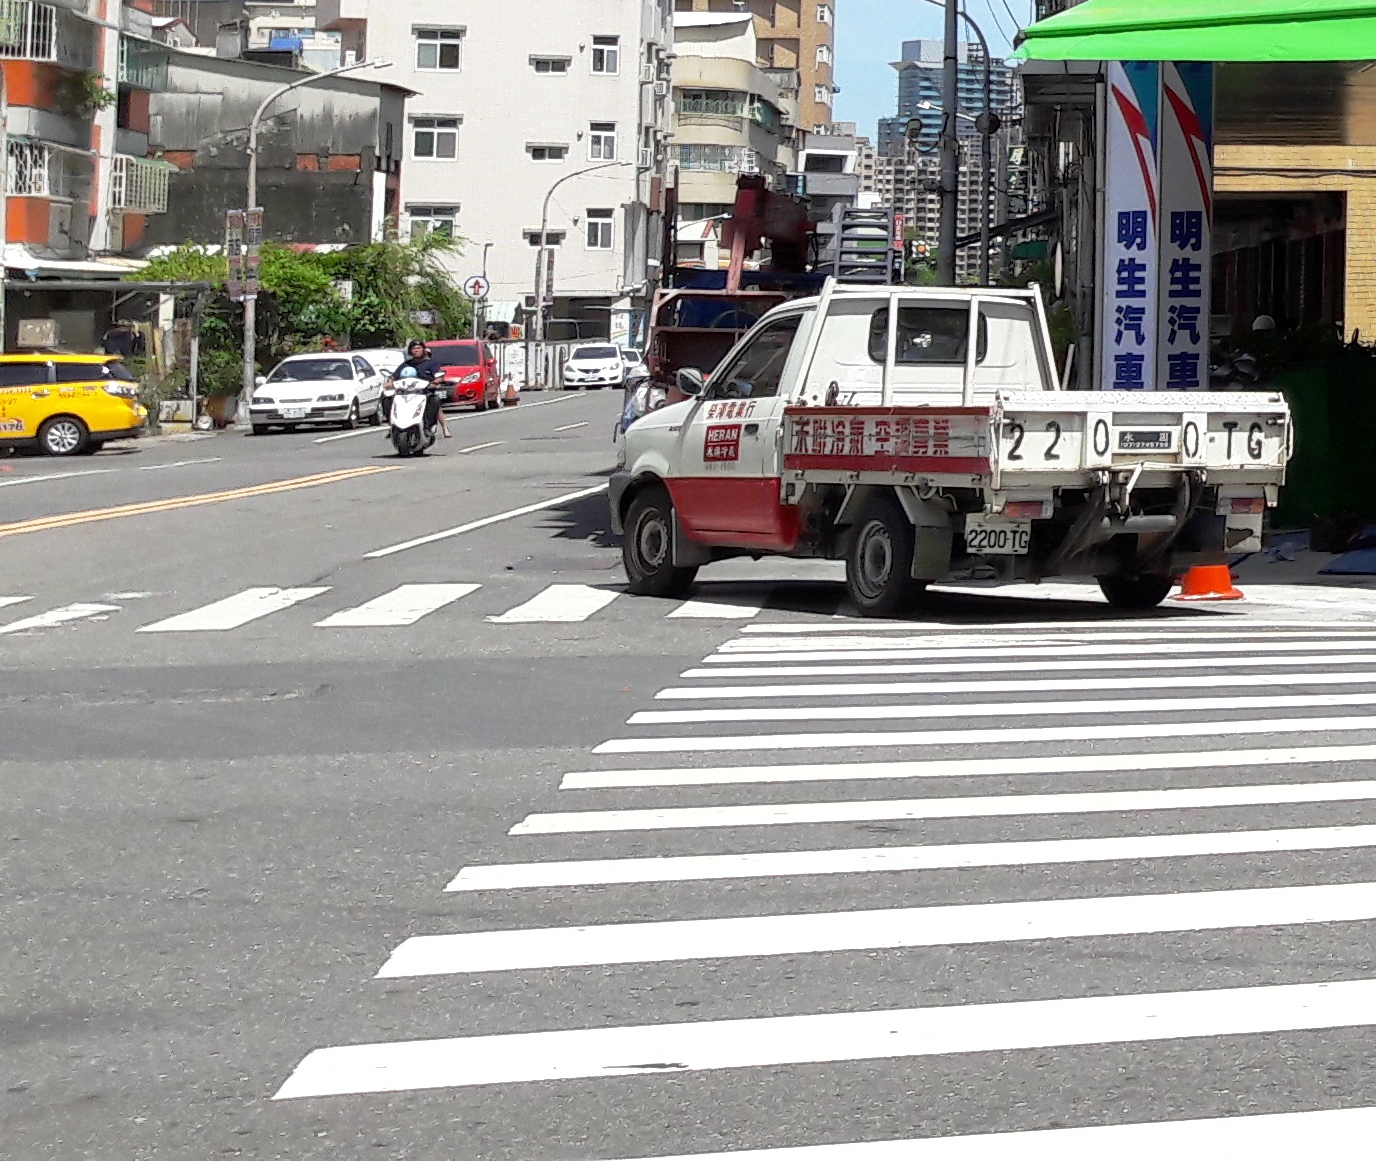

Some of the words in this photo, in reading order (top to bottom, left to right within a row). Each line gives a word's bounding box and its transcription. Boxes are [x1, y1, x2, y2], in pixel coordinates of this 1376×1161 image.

[1113, 210, 1147, 390] 明生汽車
[1167, 210, 1203, 390] 明生汽車
[708, 428, 739, 442] HERAN
[968, 529, 1028, 549] 2200-TG
